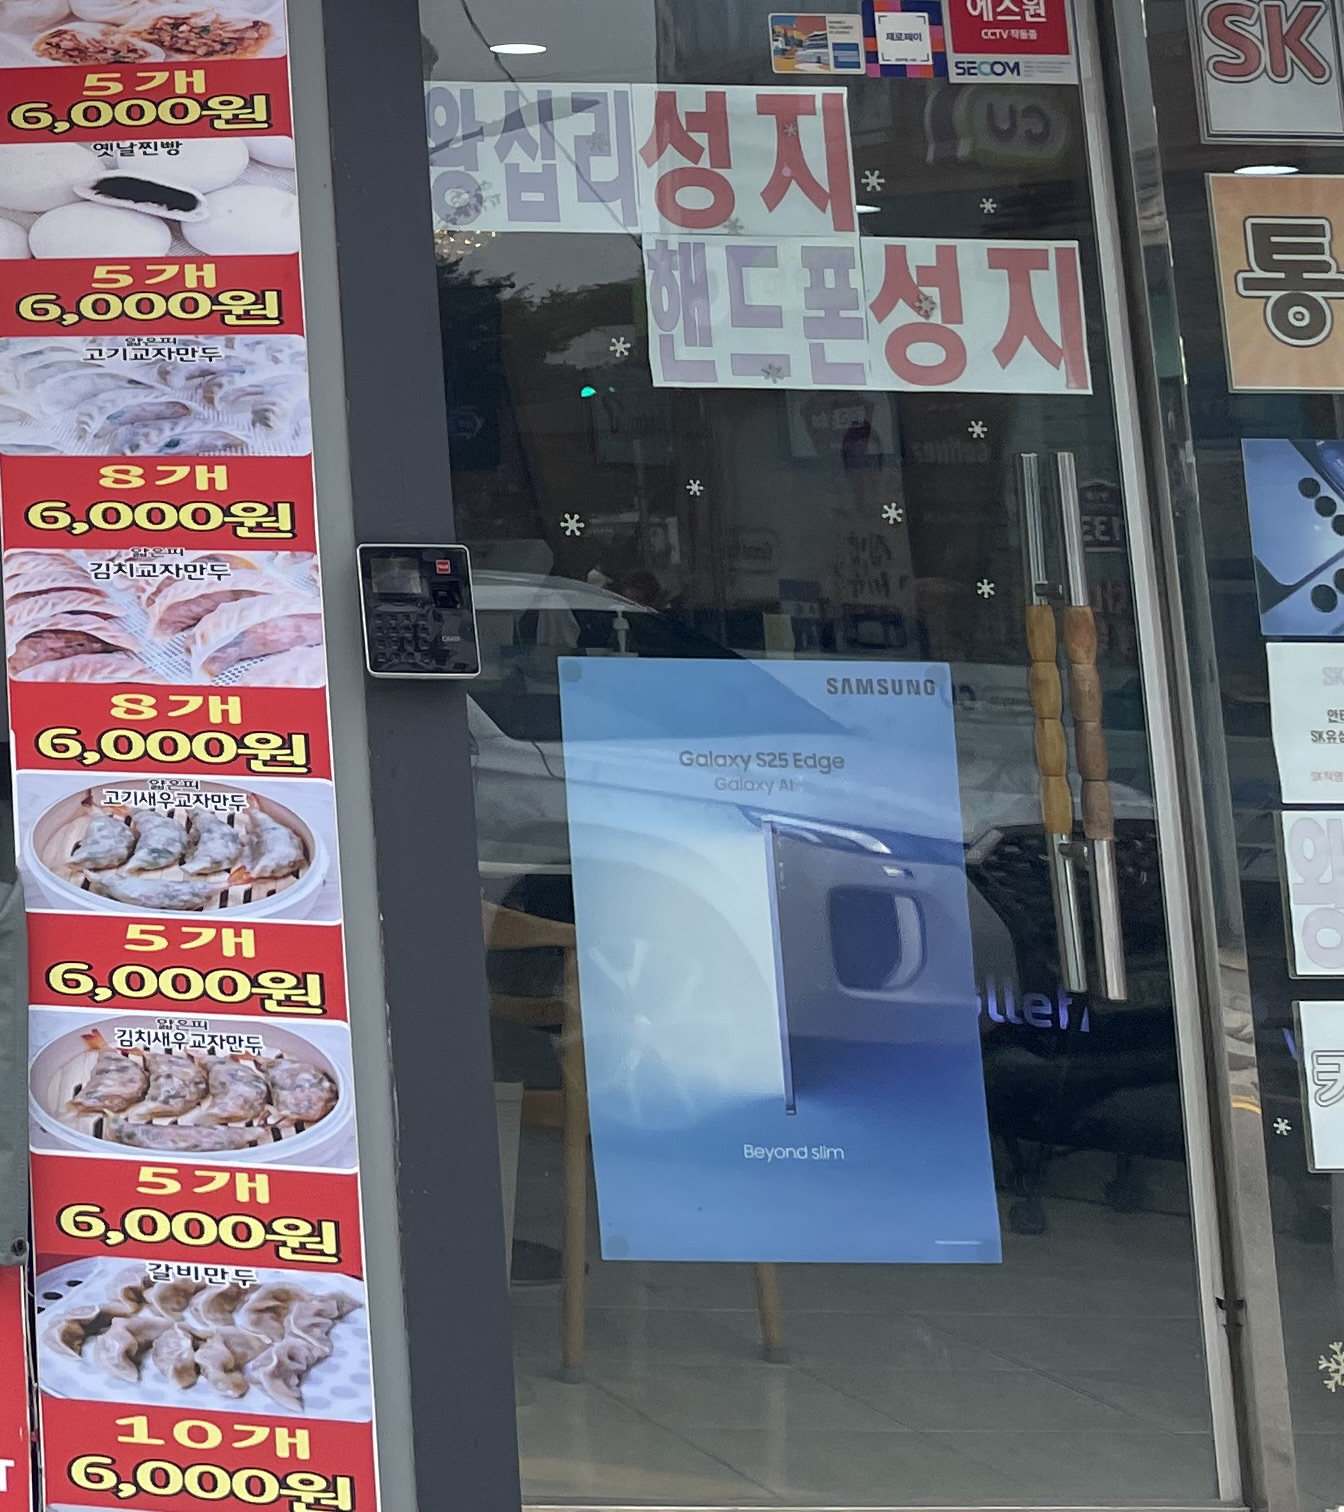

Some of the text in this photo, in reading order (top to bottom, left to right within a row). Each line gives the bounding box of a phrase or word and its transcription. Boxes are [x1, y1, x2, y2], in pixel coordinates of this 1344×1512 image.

[981, 29, 1009, 40] CCTV
[954, 61, 1021, 76] SECOM
[82, 69, 206, 95] 5개
[9, 93, 272, 134] 6,000원
[92, 140, 183, 157] 옛날찐빵
[91, 263, 217, 289] 5개
[16, 289, 285, 327] 6,000원
[82, 345, 223, 364] 고기교자만두
[99, 464, 229, 492] 8개
[25, 500, 298, 540] 6,000원
[90, 561, 232, 582] 김치교자만두
[826, 677, 936, 696] SAMSUNG
[111, 693, 243, 725] 8개
[35, 727, 312, 774] 6,000원
[678, 750, 846, 773] Galaxy S25 Edge
[714, 776, 775, 795] Galaxy
[103, 790, 250, 813] 고기새우교자만두
[124, 924, 256, 959] 5개
[46, 962, 327, 1015] 6,000원
[115, 1028, 264, 1054] 김치새우교자만두
[743, 1142, 845, 1164] Beyond slim
[136, 1167, 269, 1204] 5개
[57, 1203, 342, 1264] 6,000원
[147, 1262, 258, 1287] 갈비만두
[115, 1415, 310, 1461] 10개
[68, 1454, 355, 1512] 6,000원
